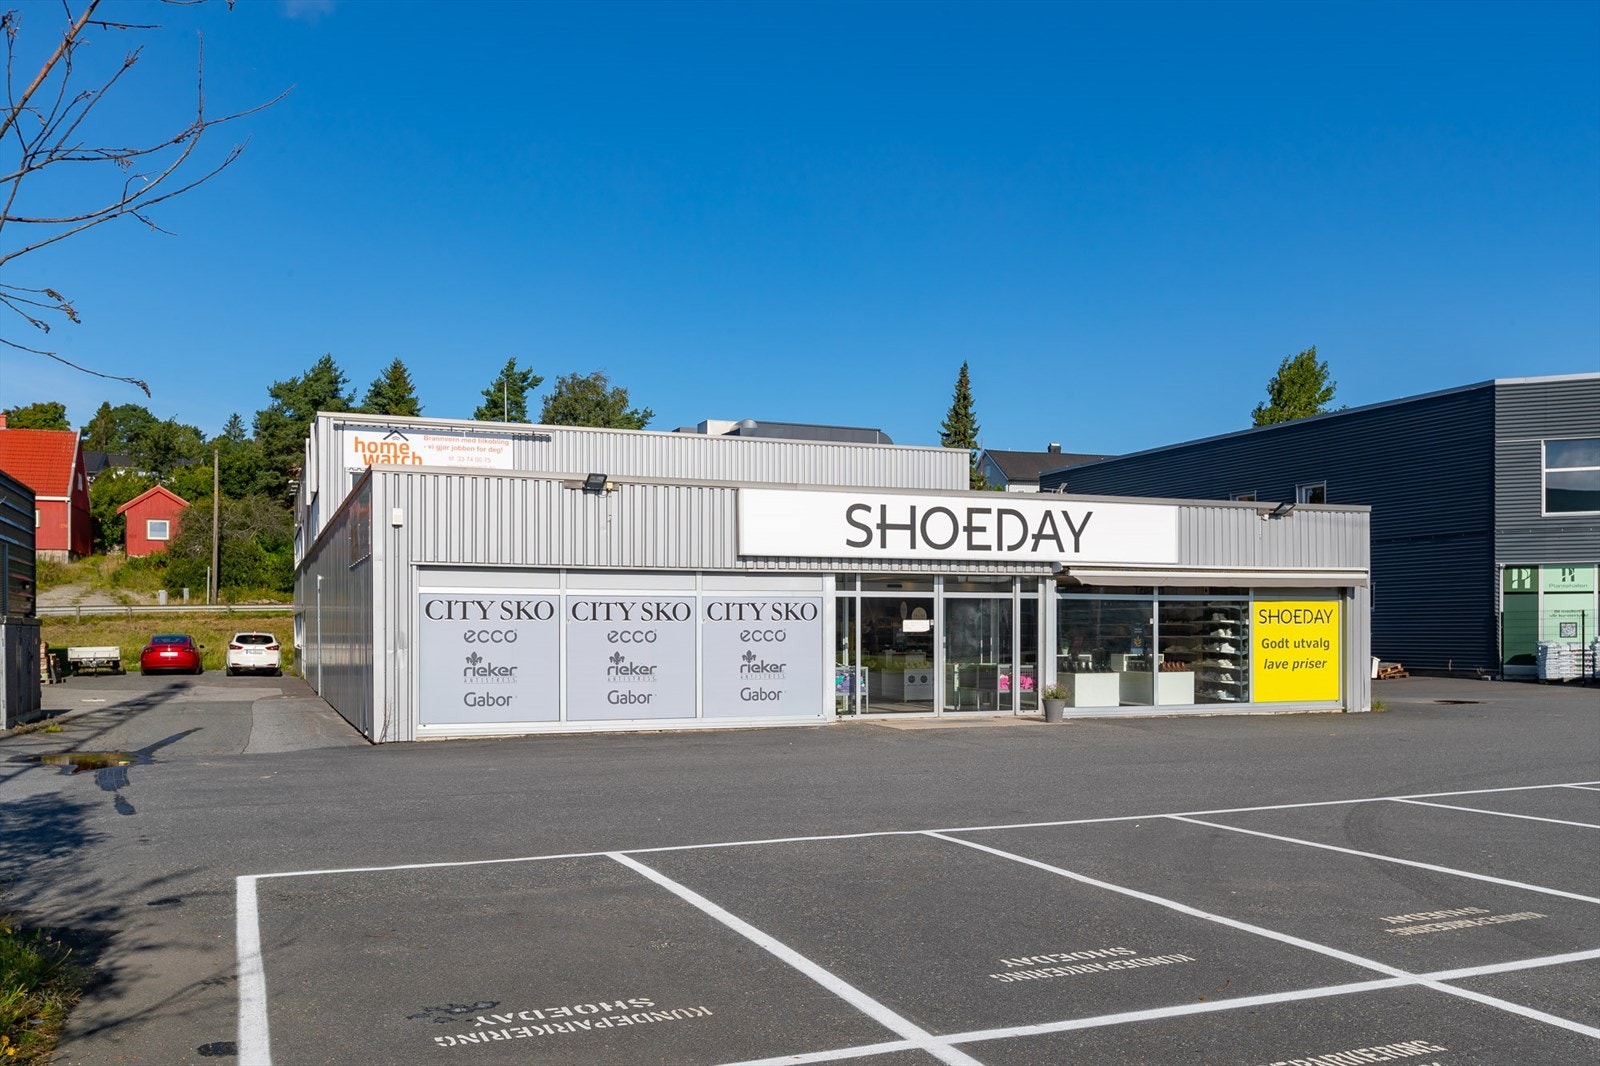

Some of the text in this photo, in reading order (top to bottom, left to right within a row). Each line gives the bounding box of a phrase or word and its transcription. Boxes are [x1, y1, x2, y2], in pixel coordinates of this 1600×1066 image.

[354, 436, 410, 455] home
[423, 435, 460, 443] Brannvern
[478, 437, 510, 447] tilkobling
[435, 444, 450, 452] gjør
[363, 451, 423, 466] watch
[845, 503, 1094, 554] SHOEDAY
[425, 599, 555, 621] CITY SKO
[571, 601, 691, 622] CITY SKO
[706, 602, 818, 621] CITY SKO
[1258, 609, 1334, 624] SHOEDAY
[463, 629, 517, 643] ecco
[607, 630, 657, 643] ecco
[740, 629, 786, 642] ecco
[1261, 637, 1330, 651] Godt utvalg
[463, 662, 518, 677] rieker
[607, 661, 657, 675] rieker
[740, 660, 787, 673] rieker
[1263, 658, 1327, 672] lave priser
[463, 691, 513, 707] Gabor
[607, 690, 653, 705] Gabor
[740, 687, 783, 702] Gabor
[1000, 946, 1137, 967] SHOEDAY
[989, 953, 1196, 983] KUNDEPARKERING
[474, 998, 656, 1027] SHOEDAY
[434, 1005, 713, 1047] KUNDEPARKERING
